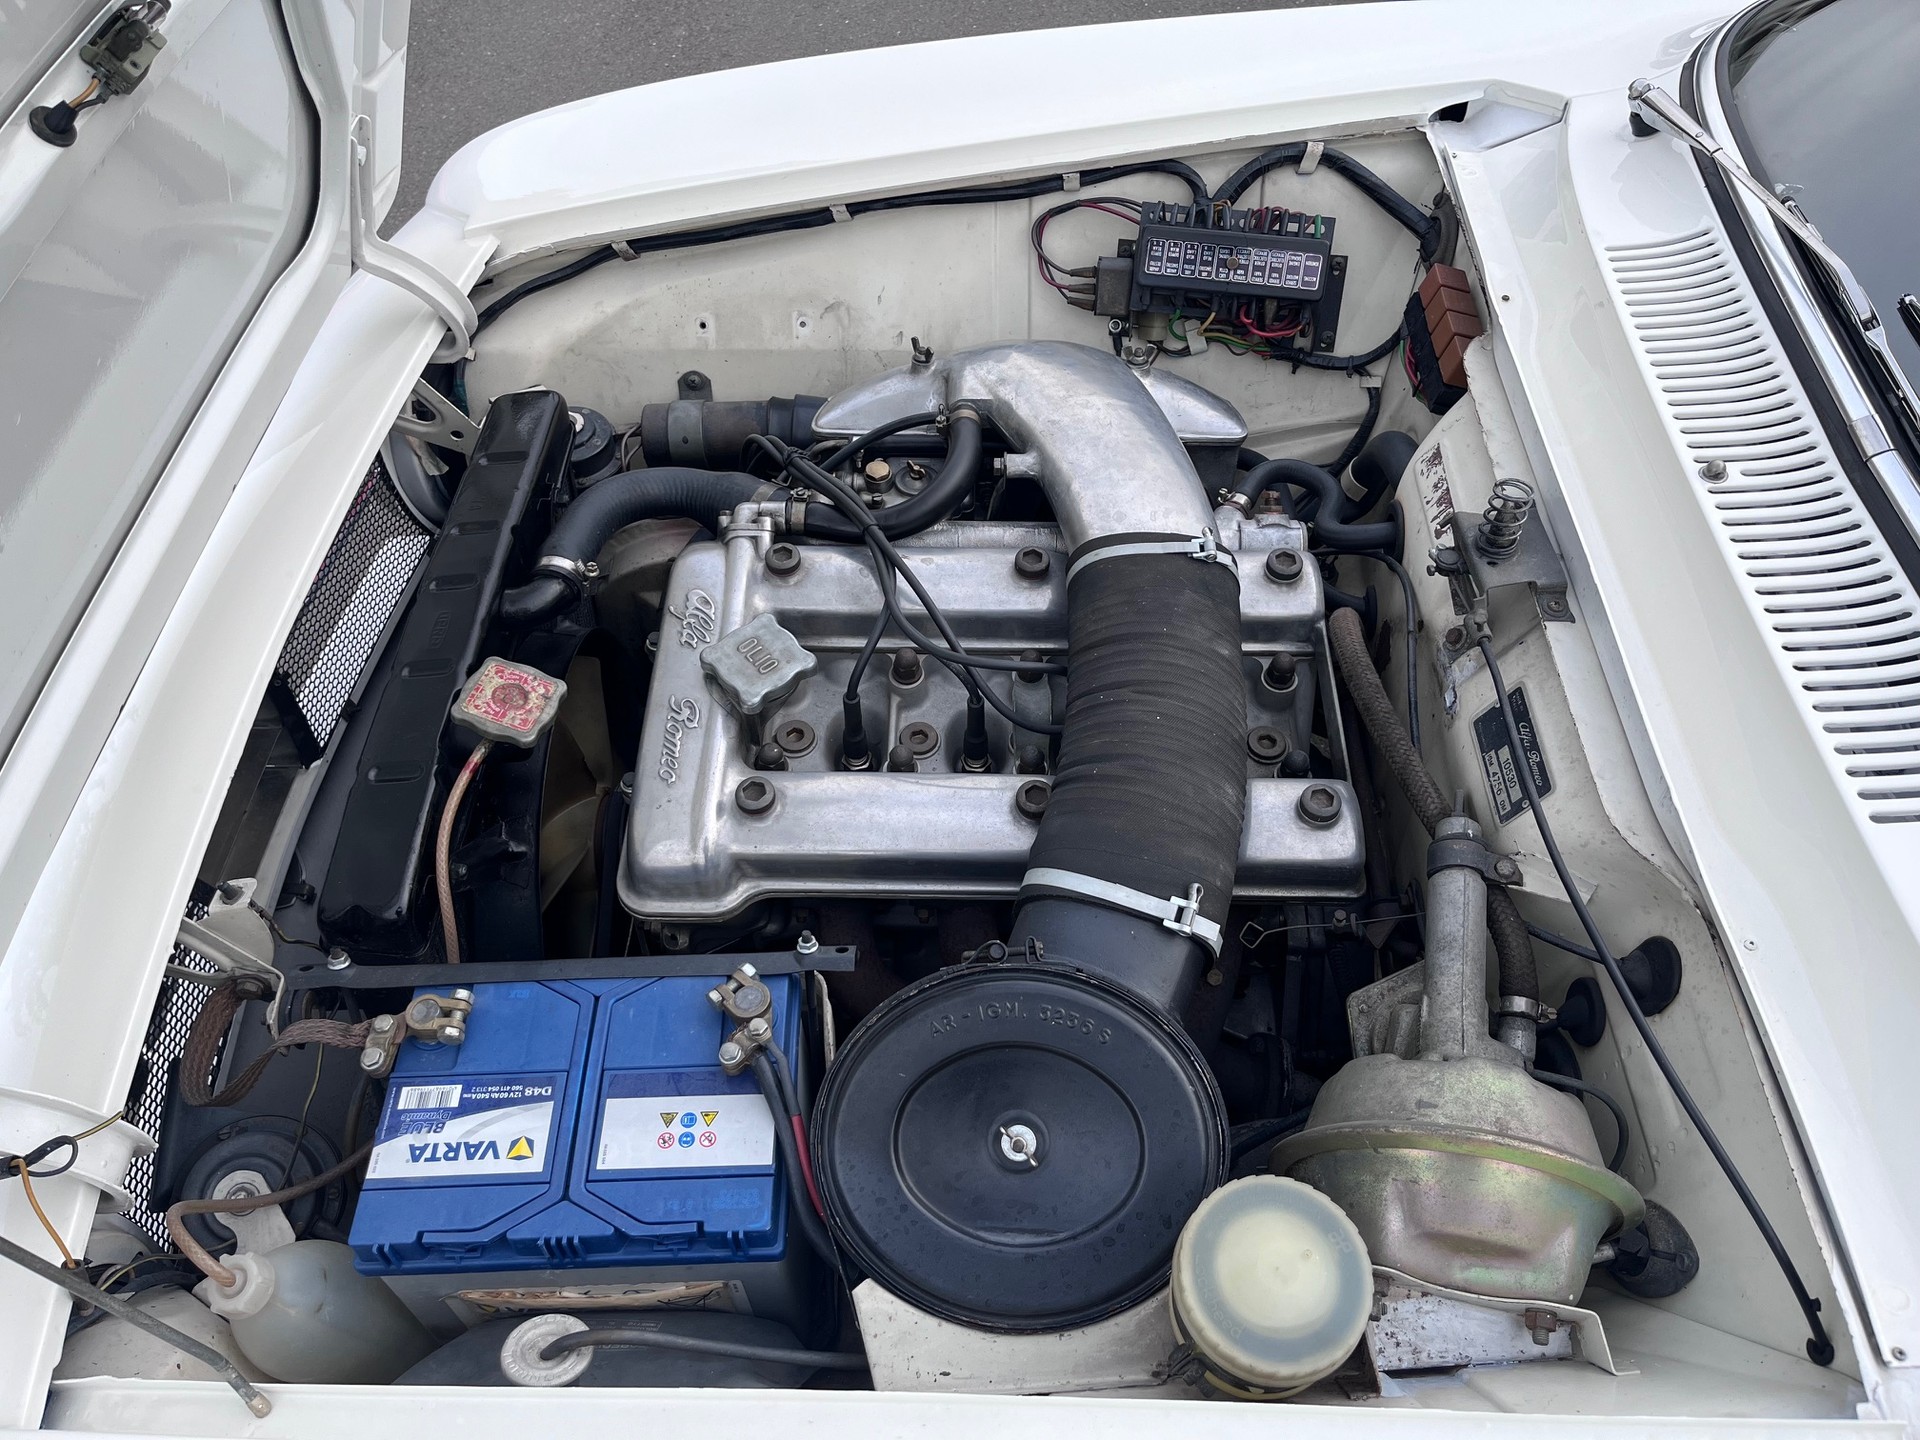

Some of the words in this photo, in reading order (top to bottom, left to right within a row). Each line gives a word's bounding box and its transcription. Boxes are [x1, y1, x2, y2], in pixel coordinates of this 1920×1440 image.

[668, 589, 715, 648] Alfa
[737, 637, 779, 674] OLIO
[659, 695, 700, 784] Romeo
[1527, 750, 1542, 786] Romeo
[524, 1085, 551, 1096] D48
[398, 1120, 445, 1135] BLUE
[400, 1109, 451, 1122] Dynamic
[408, 1139, 500, 1163] VARTA
